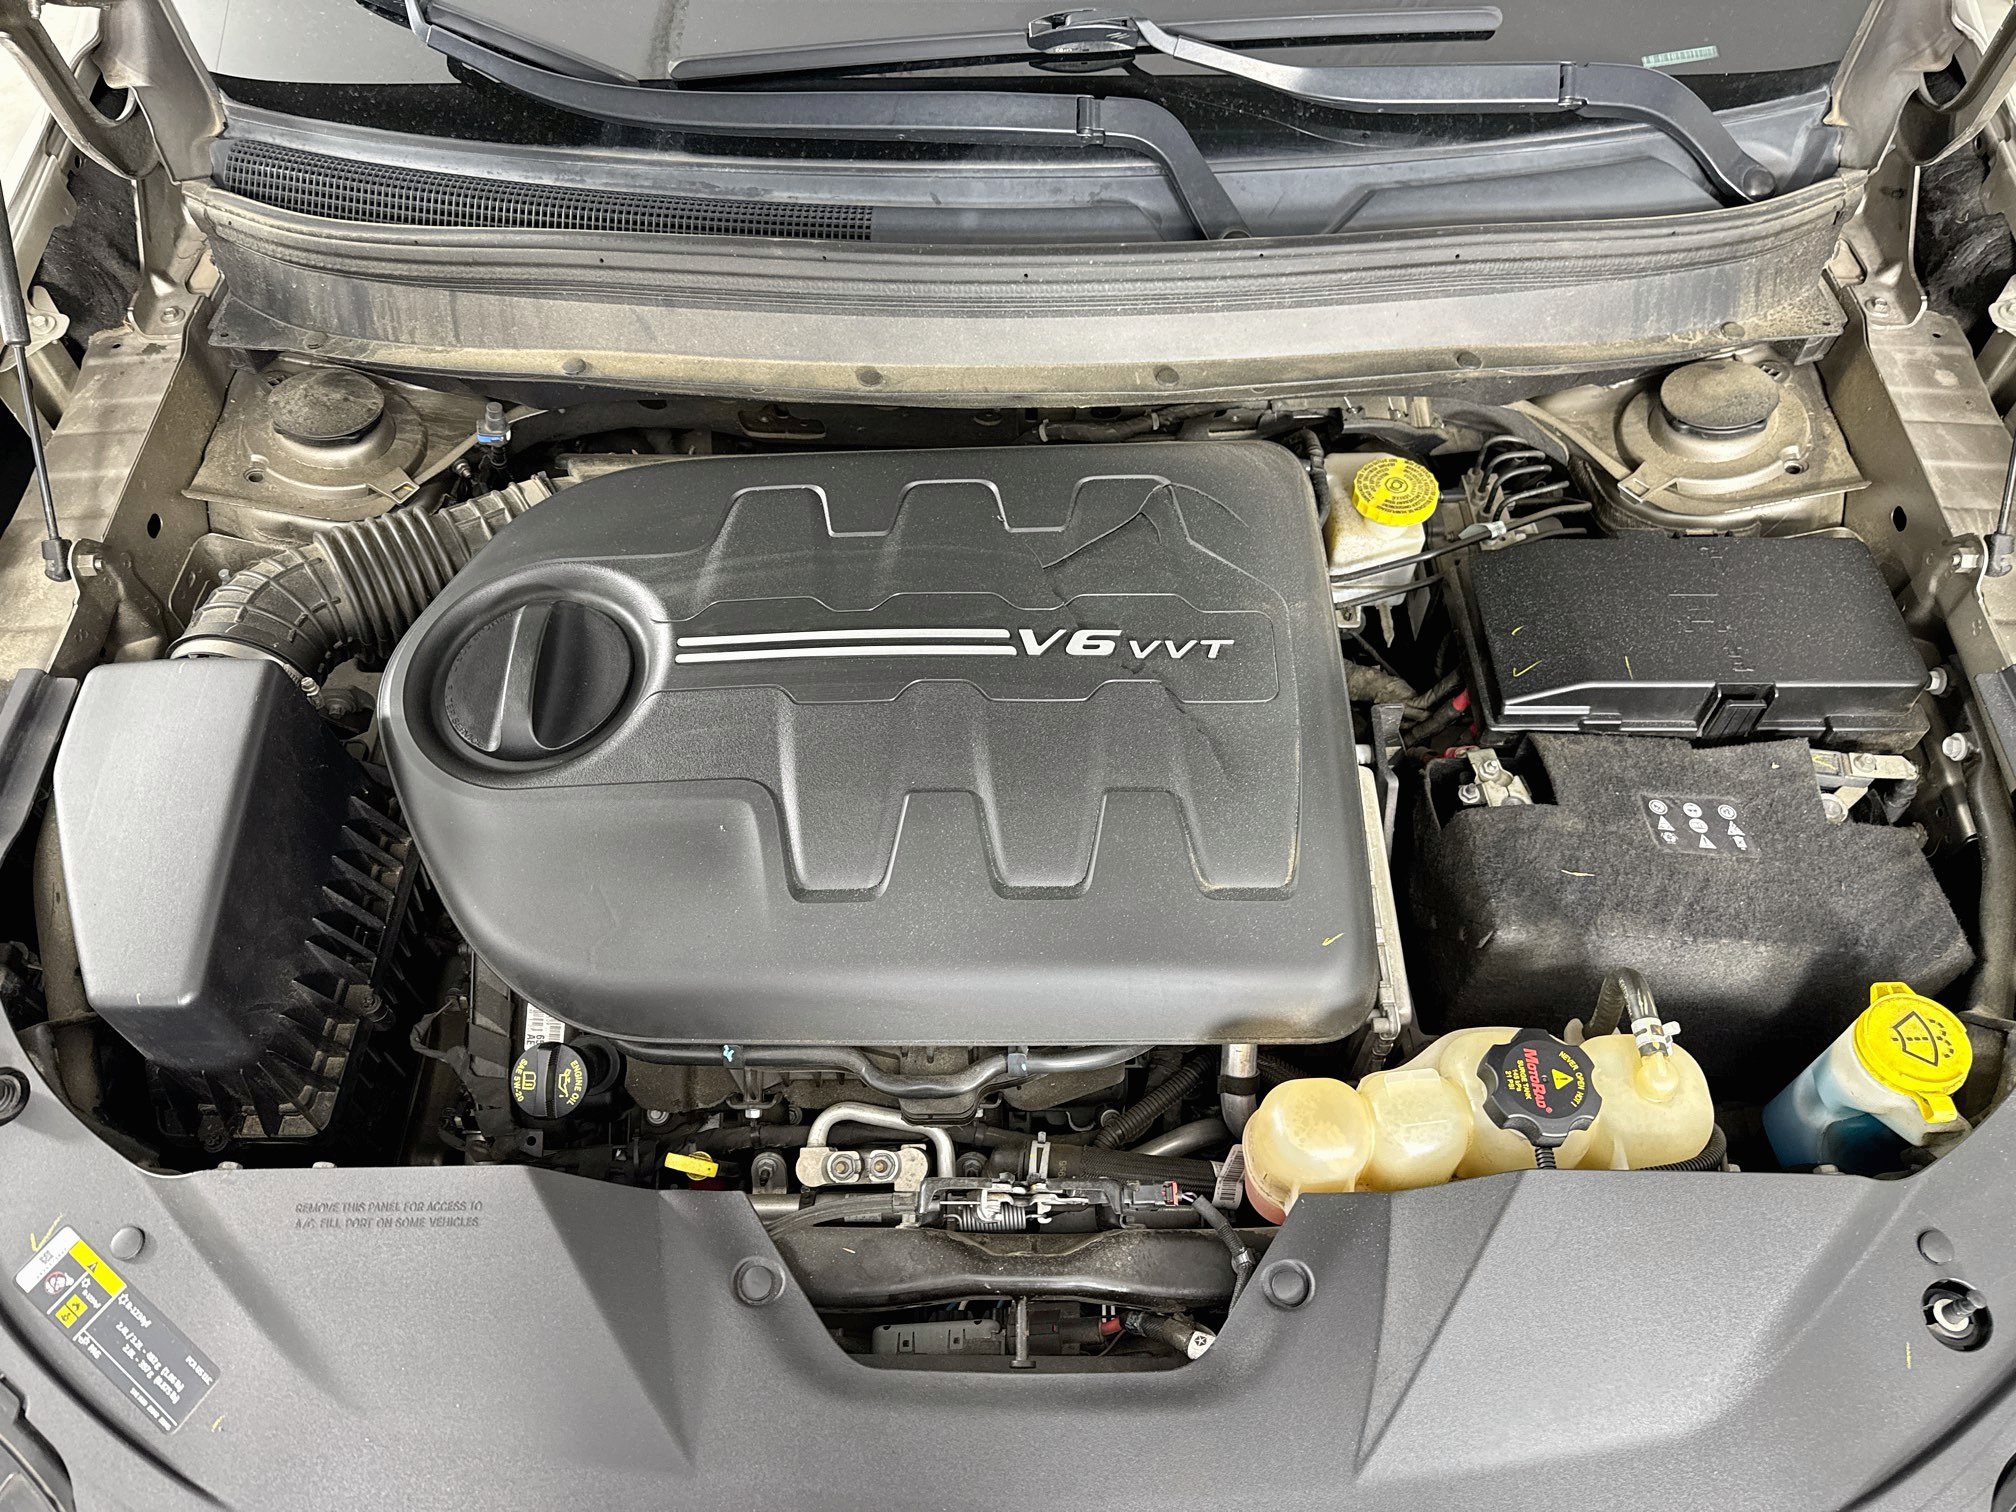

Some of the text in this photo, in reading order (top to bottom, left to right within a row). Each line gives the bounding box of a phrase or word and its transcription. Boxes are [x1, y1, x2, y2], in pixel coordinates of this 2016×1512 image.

[1018, 629, 1235, 659] V6 VVT
[513, 1059, 528, 1102] SAE 5W-20
[566, 1060, 583, 1105] ENGINE OIL
[1507, 1078, 1515, 1090] PSI
[1517, 1059, 1532, 1100] SURGE TANK
[1559, 1051, 1579, 1071] NEVER
[1575, 1072, 1585, 1090] OPEN
[295, 1200, 483, 1214] REMOVE THIS PANEL FOR ACCESS TO
[320, 1217, 341, 1229] FILL
[345, 1217, 374, 1229] PORT
[376, 1217, 393, 1228] ON
[394, 1216, 426, 1228] SOME
[429, 1216, 479, 1228] VEHICLES
